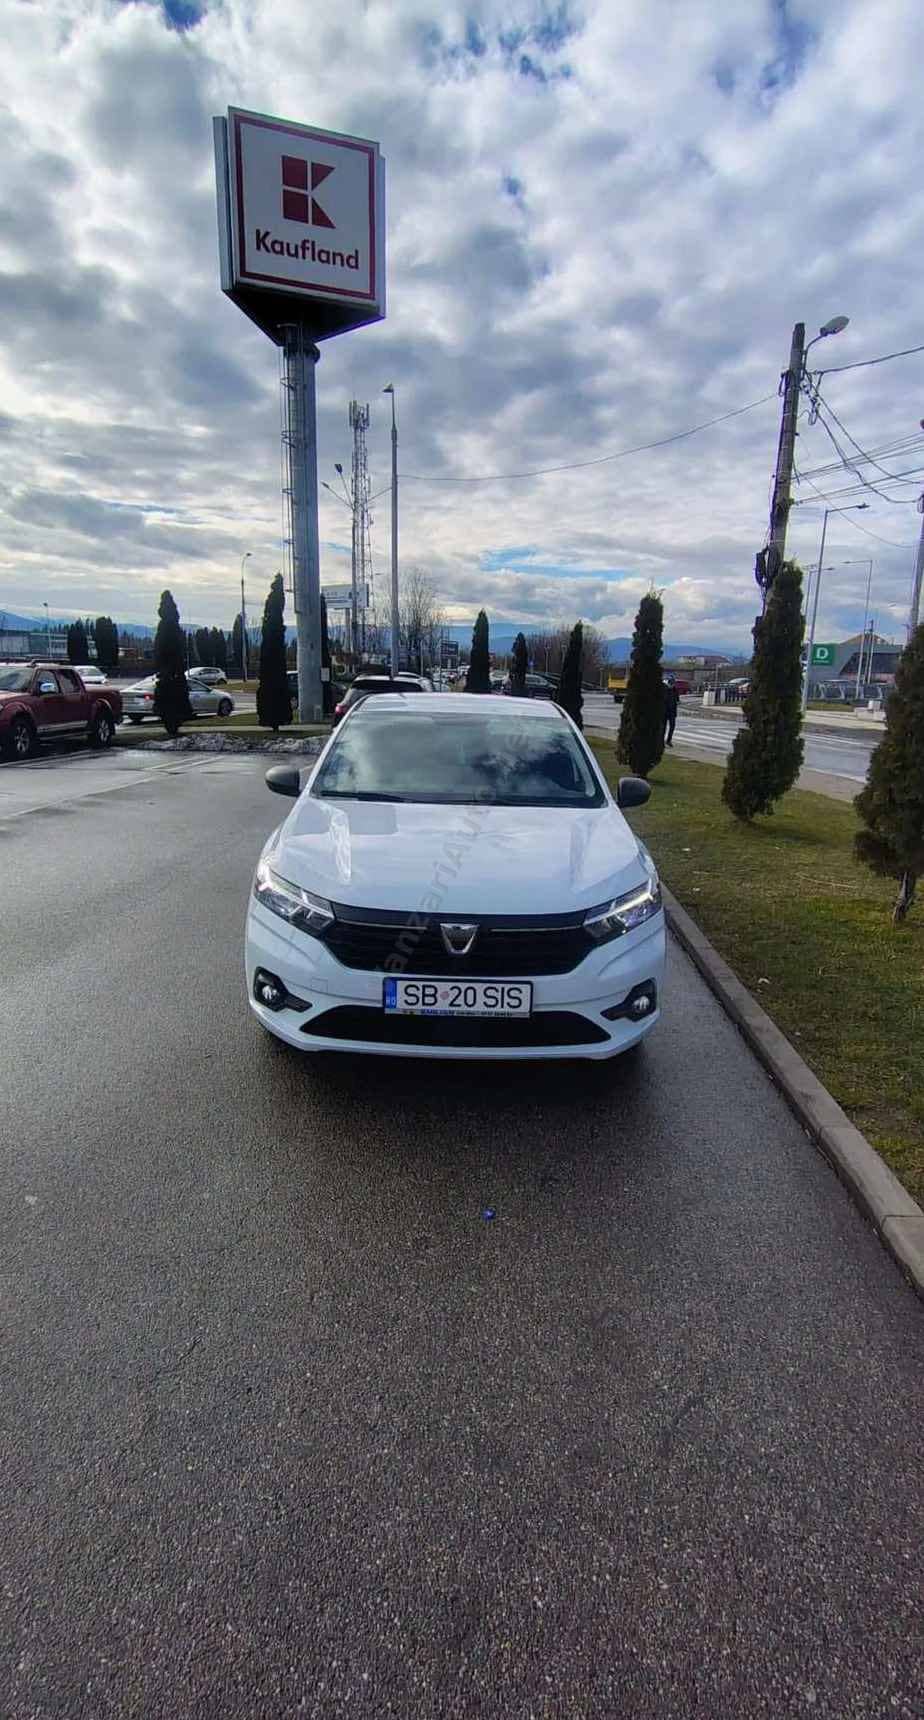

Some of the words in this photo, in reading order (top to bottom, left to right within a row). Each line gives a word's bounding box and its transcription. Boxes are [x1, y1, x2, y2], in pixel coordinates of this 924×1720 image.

[255, 229, 359, 270] Kaufland
[816, 647, 829, 659] D
[403, 984, 438, 1007] SB
[449, 986, 477, 1008] 20
[483, 986, 523, 1009] SIS
